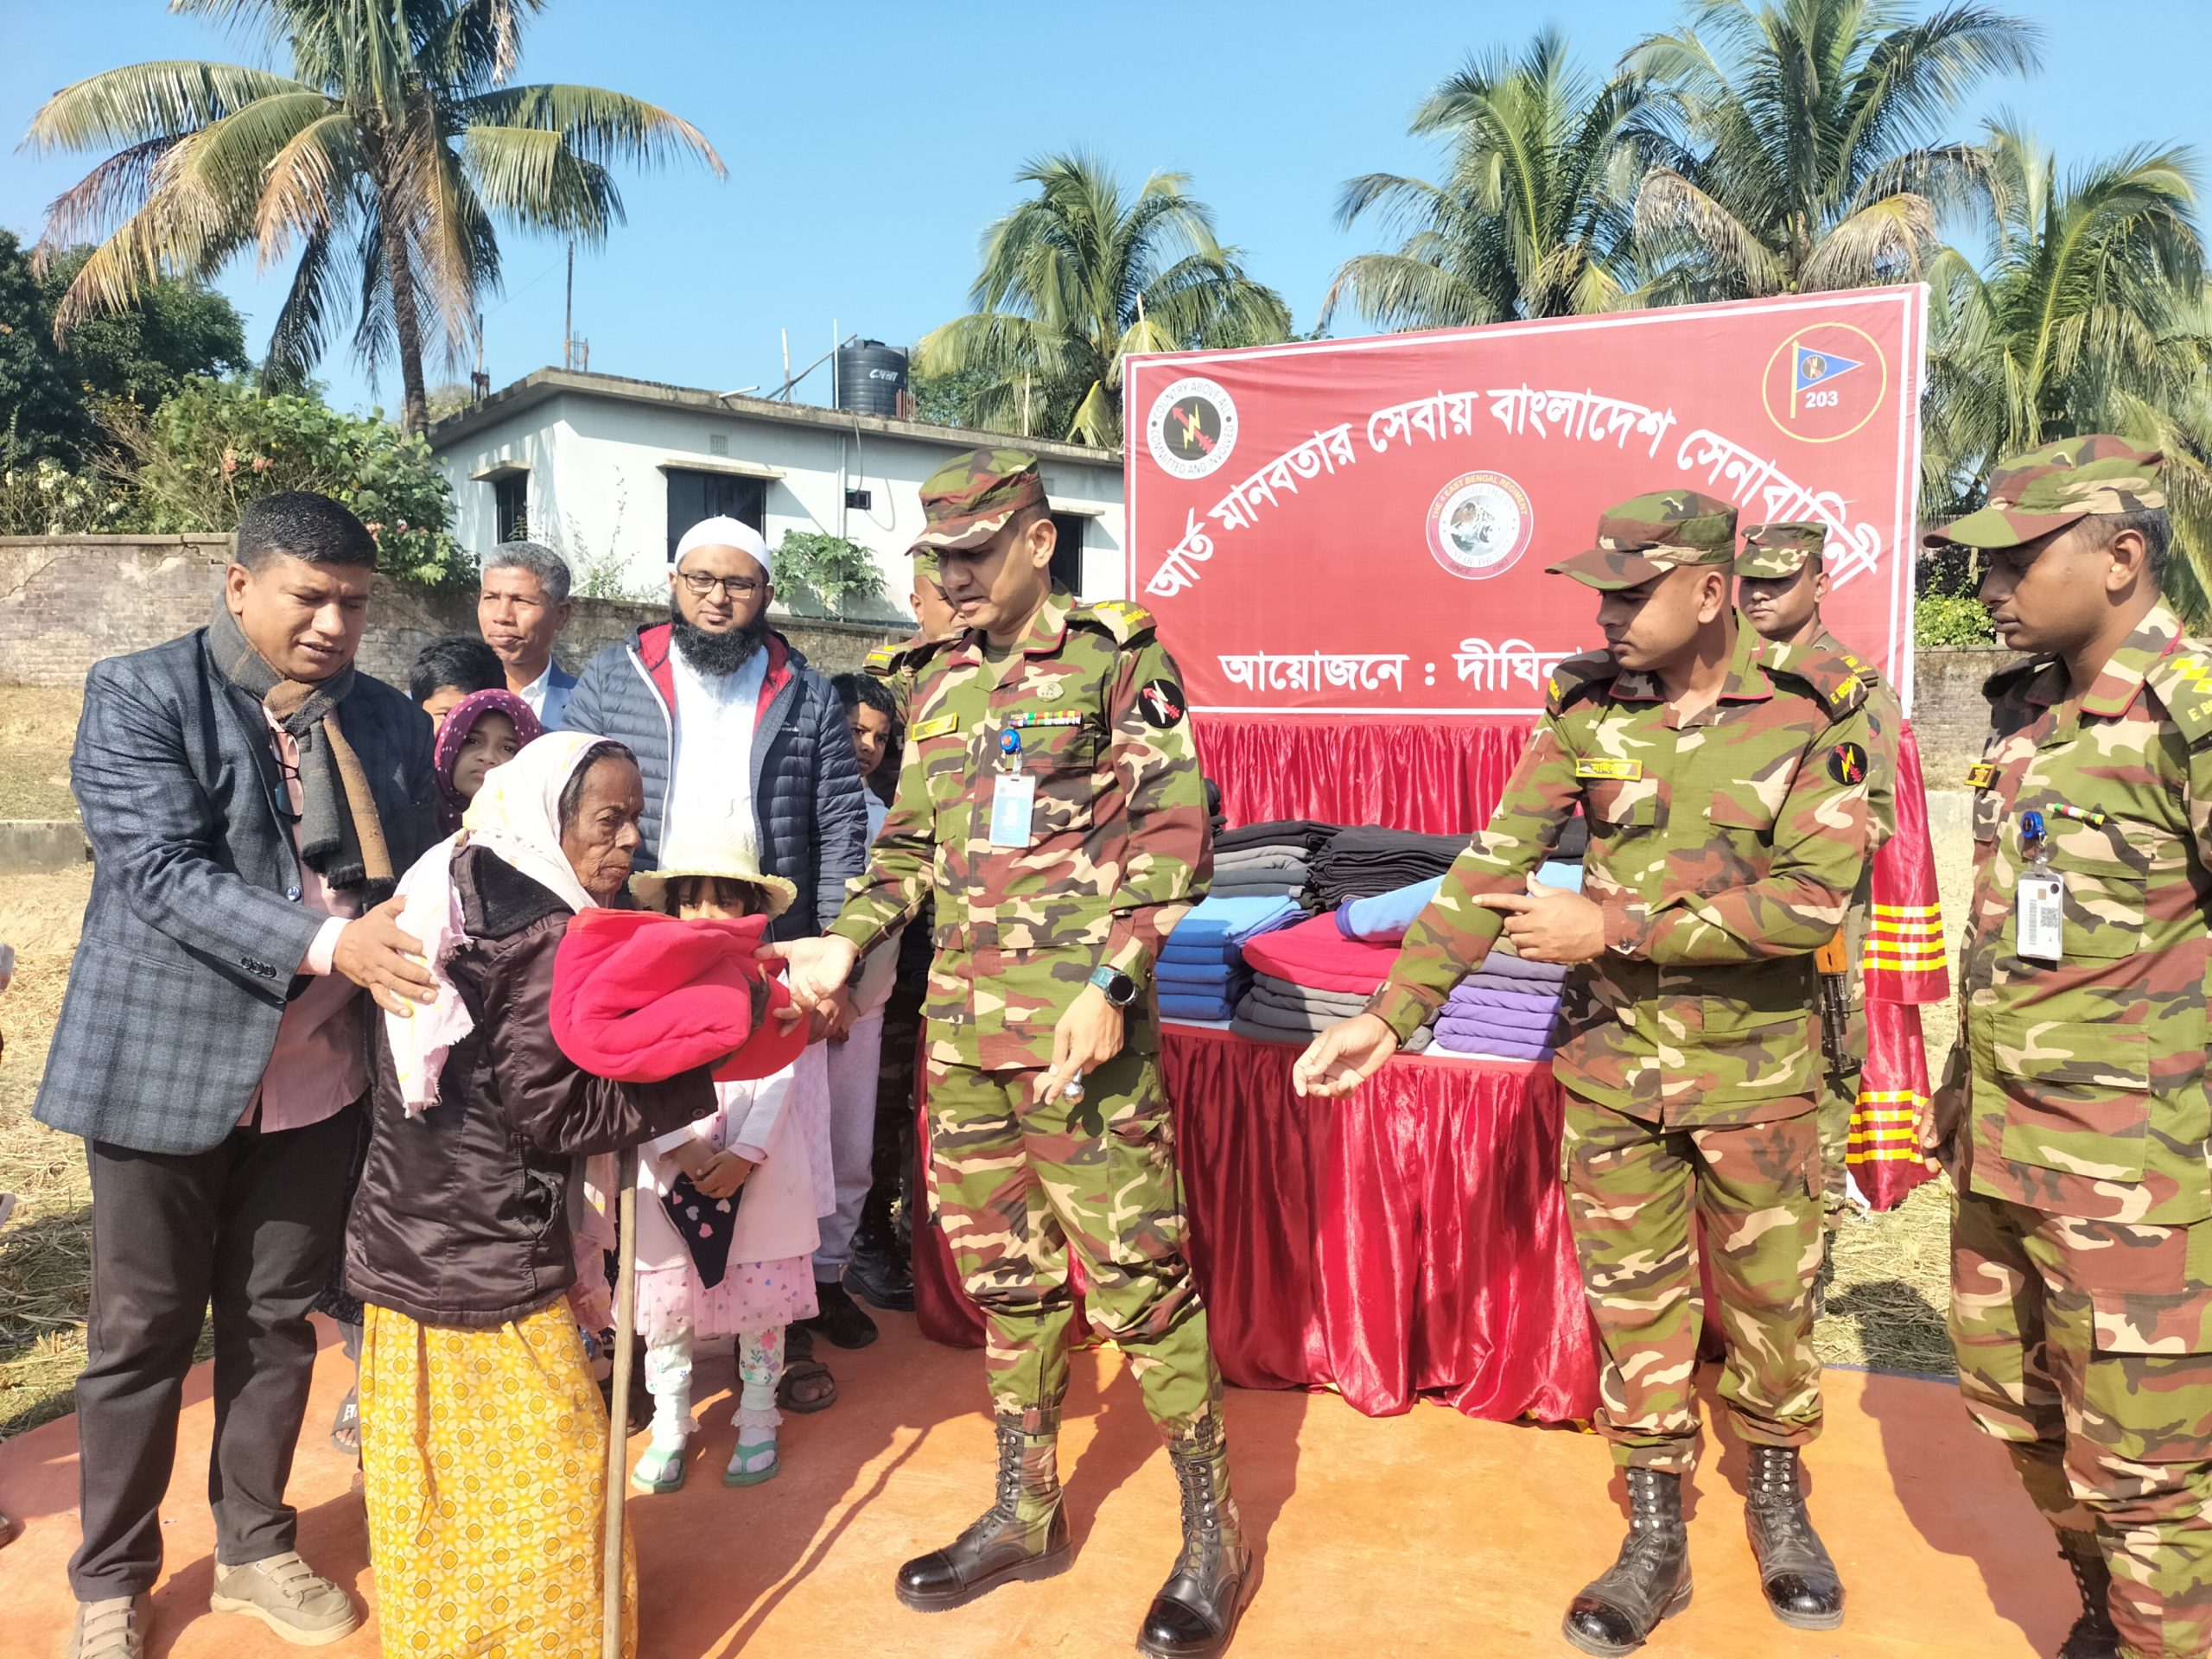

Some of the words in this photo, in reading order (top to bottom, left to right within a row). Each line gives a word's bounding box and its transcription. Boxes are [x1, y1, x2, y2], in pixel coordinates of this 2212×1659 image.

[1154, 383, 1188, 419] COUNTRY
[1191, 382, 1221, 400] ABOVE
[1219, 398, 1231, 415] ALL
[1804, 391, 1839, 409] 203
[1187, 462, 1207, 474] AND
[1145, 507, 1214, 597] আর্ত
[1207, 423, 1357, 531] মানবতার
[1368, 390, 1478, 454] সেবায়
[1486, 382, 1677, 459] বাংলাদেশ
[1444, 479, 1464, 497] EAST
[1465, 474, 1498, 485] BENGAL
[1499, 479, 1528, 515] REGIMENT
[1217, 650, 1410, 692] আয়োজনে
